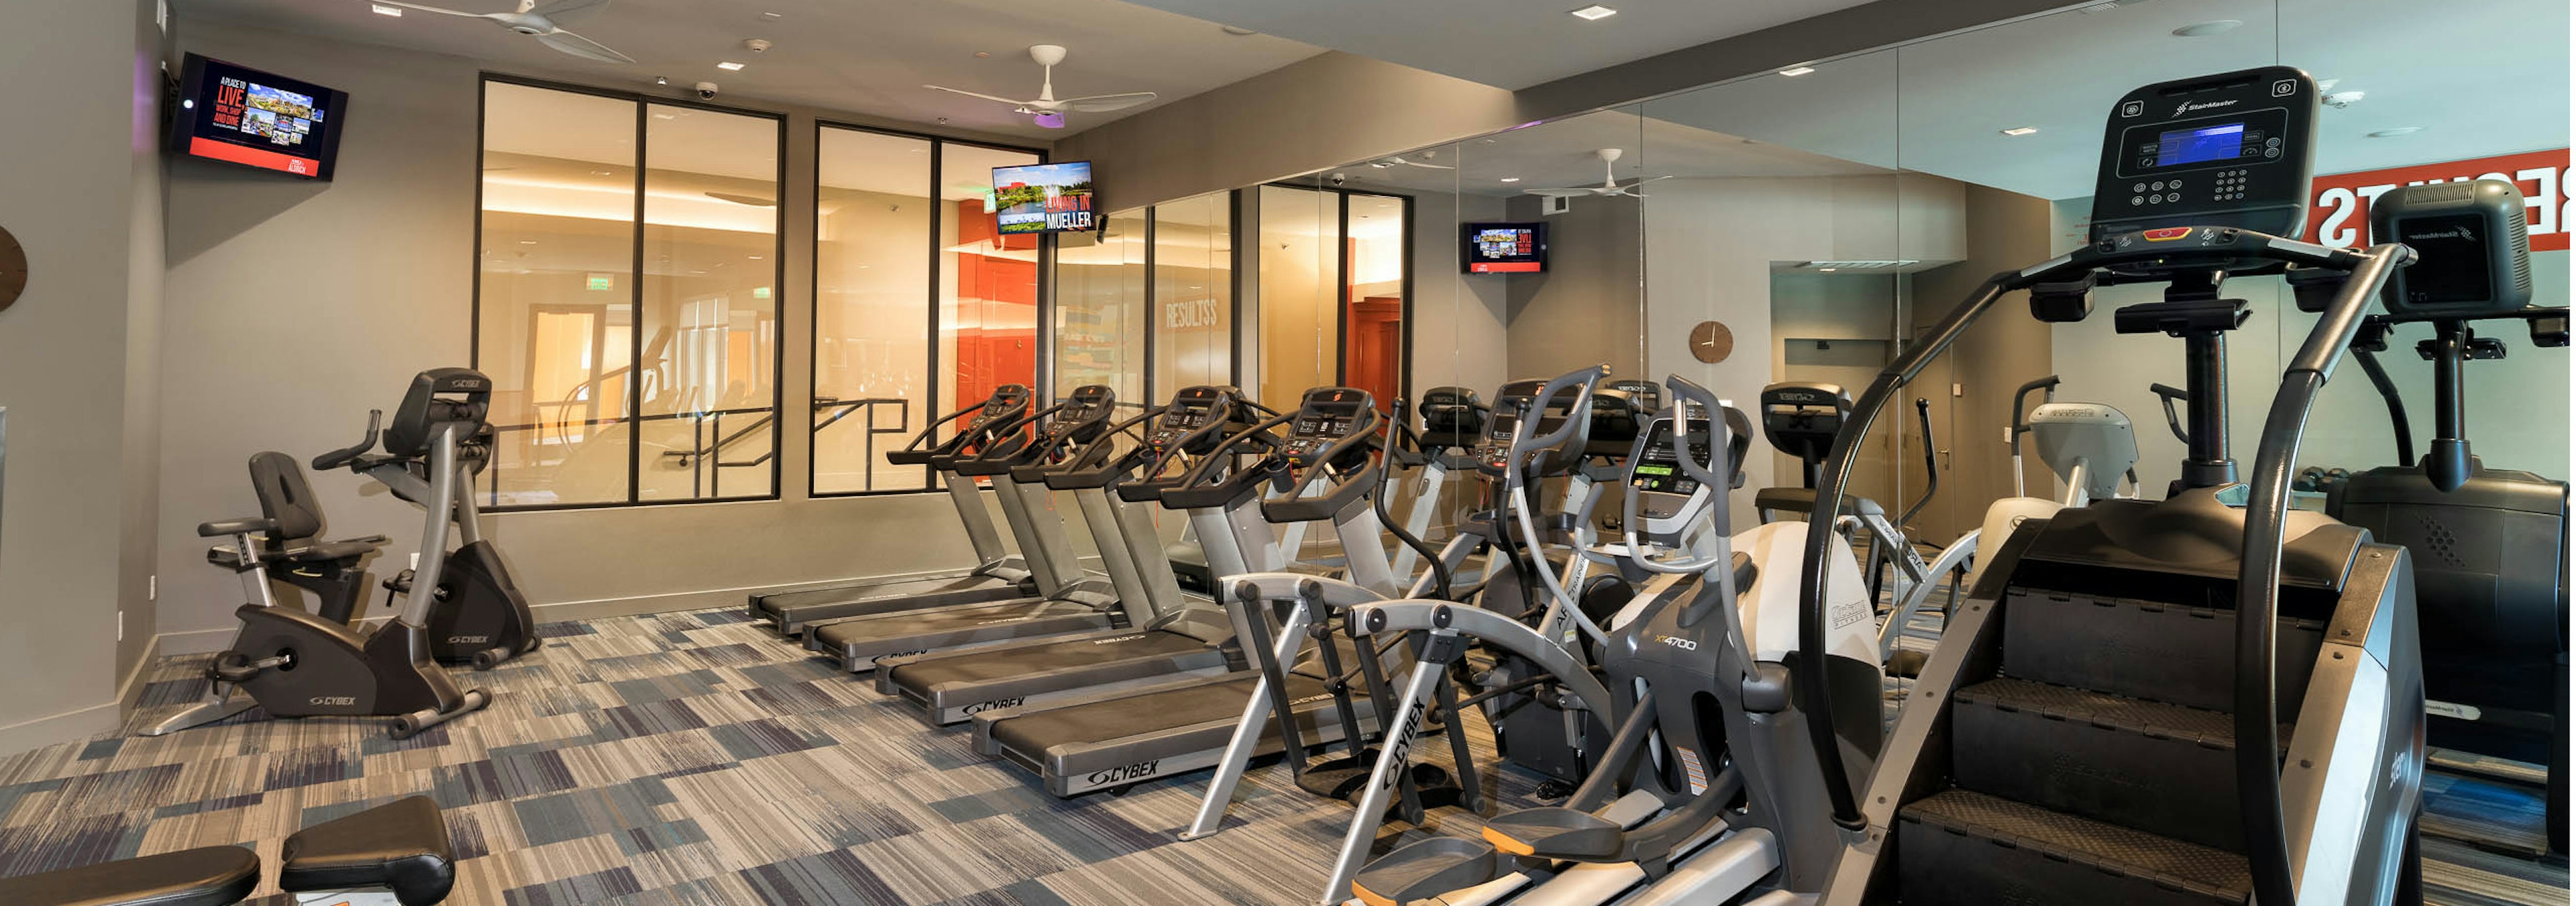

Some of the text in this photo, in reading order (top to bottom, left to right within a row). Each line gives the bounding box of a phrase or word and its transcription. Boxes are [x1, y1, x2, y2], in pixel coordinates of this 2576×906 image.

[220, 76, 247, 89] A PLACE TO
[217, 85, 246, 111] LIVE,
[2188, 99, 2239, 111] StairMaster
[213, 112, 227, 124] AND
[226, 115, 240, 127] DINE
[1045, 195, 1090, 213] LIVING IN
[1046, 211, 1091, 229] MUELLER
[324, 697, 356, 706] CYBEX
[1394, 695, 1426, 765] CYBEX
[1110, 760, 1159, 783] CYBEX
